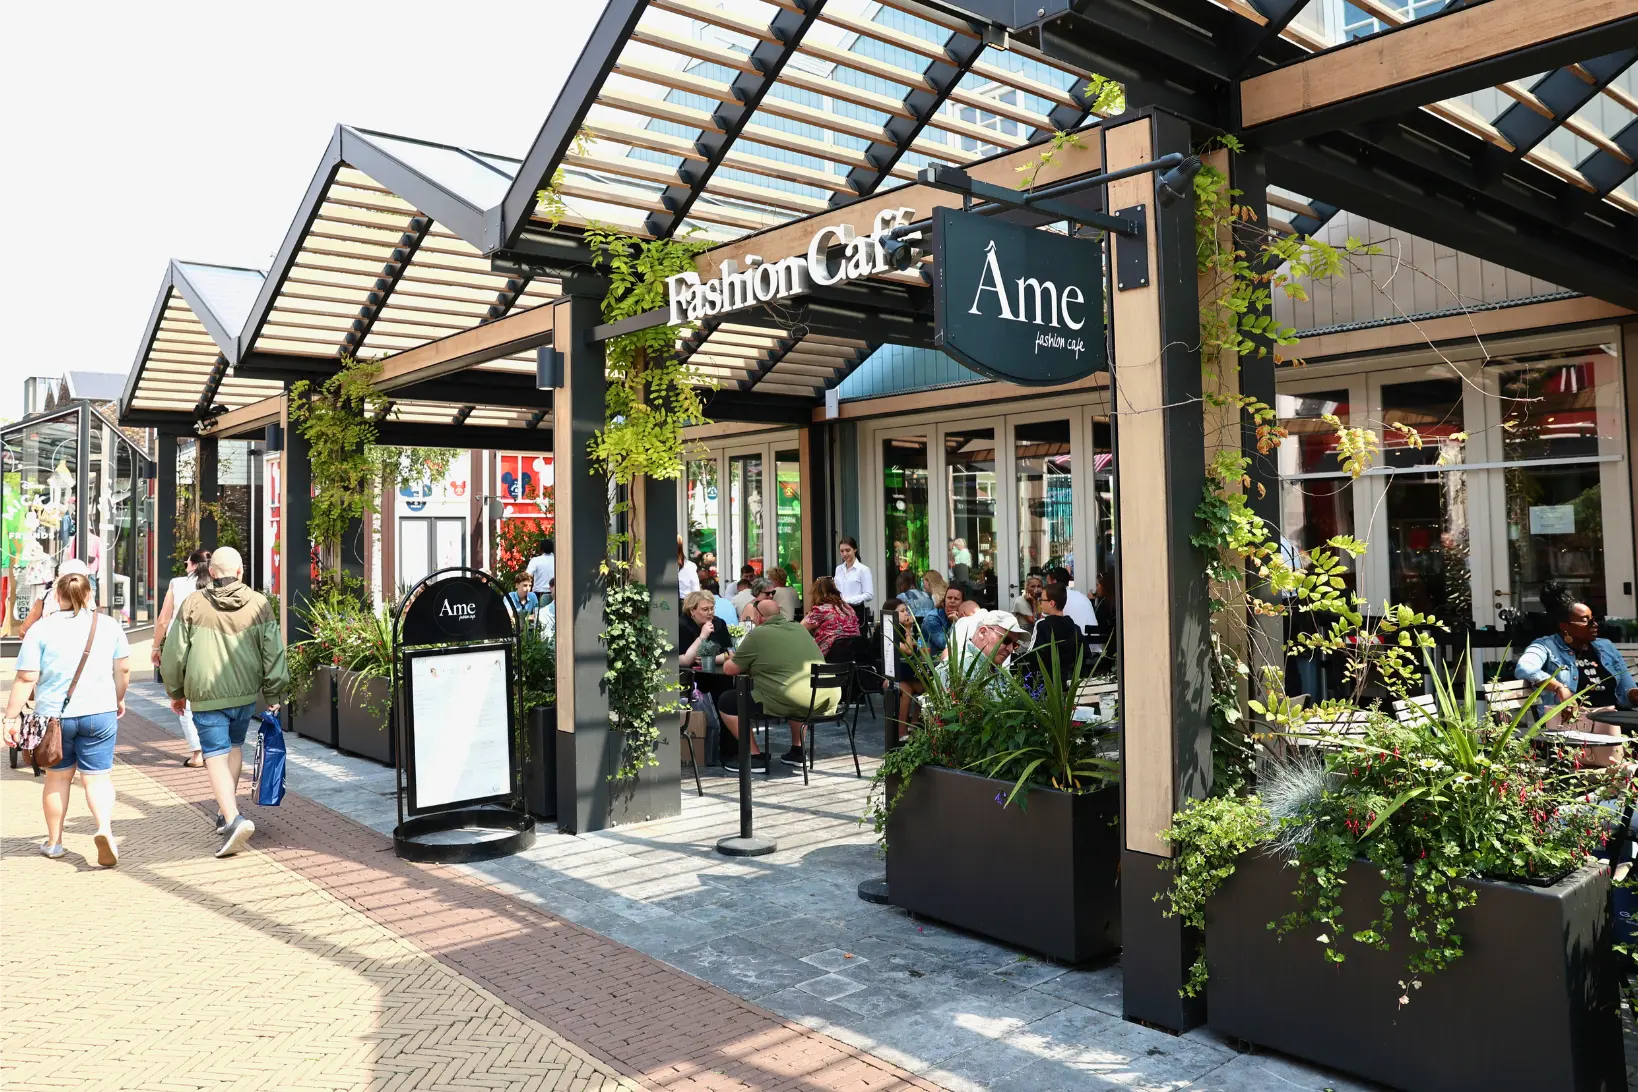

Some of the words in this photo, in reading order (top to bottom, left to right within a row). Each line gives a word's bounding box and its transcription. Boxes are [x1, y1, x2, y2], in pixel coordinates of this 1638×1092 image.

[666, 254, 808, 327] Fashion
[968, 240, 1086, 331] Âme
[1035, 331, 1065, 355] fashion
[1067, 337, 1086, 360] cafe
